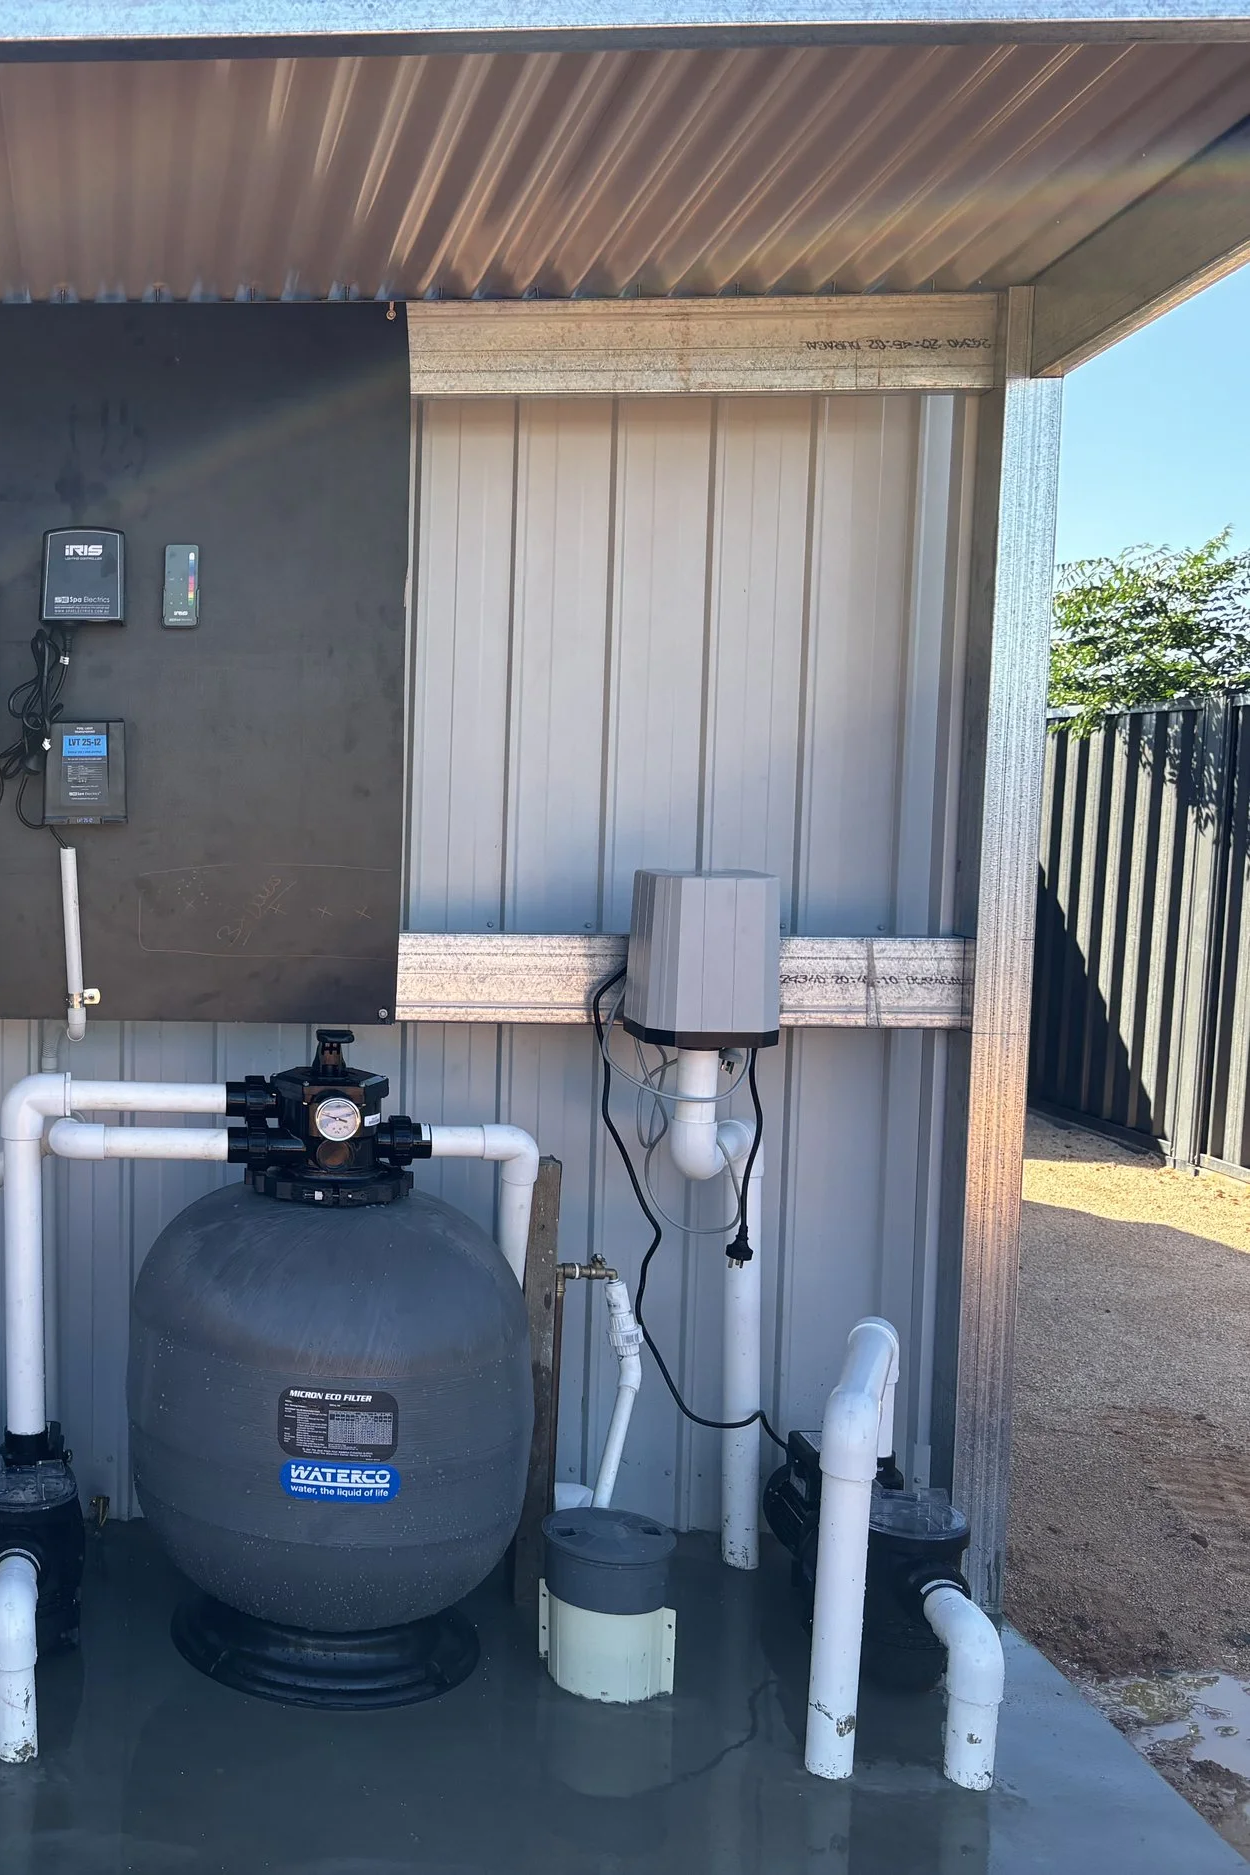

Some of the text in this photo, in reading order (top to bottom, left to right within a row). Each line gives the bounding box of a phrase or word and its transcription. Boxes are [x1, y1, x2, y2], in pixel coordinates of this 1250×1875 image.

[70, 596, 82, 604] Spa
[68, 738, 102, 747] LVT 25-12
[289, 1389, 373, 1403] MICRON ECO FILTER
[290, 1464, 390, 1484] WATERCO
[290, 1485, 389, 1498] water, the liquid of life
